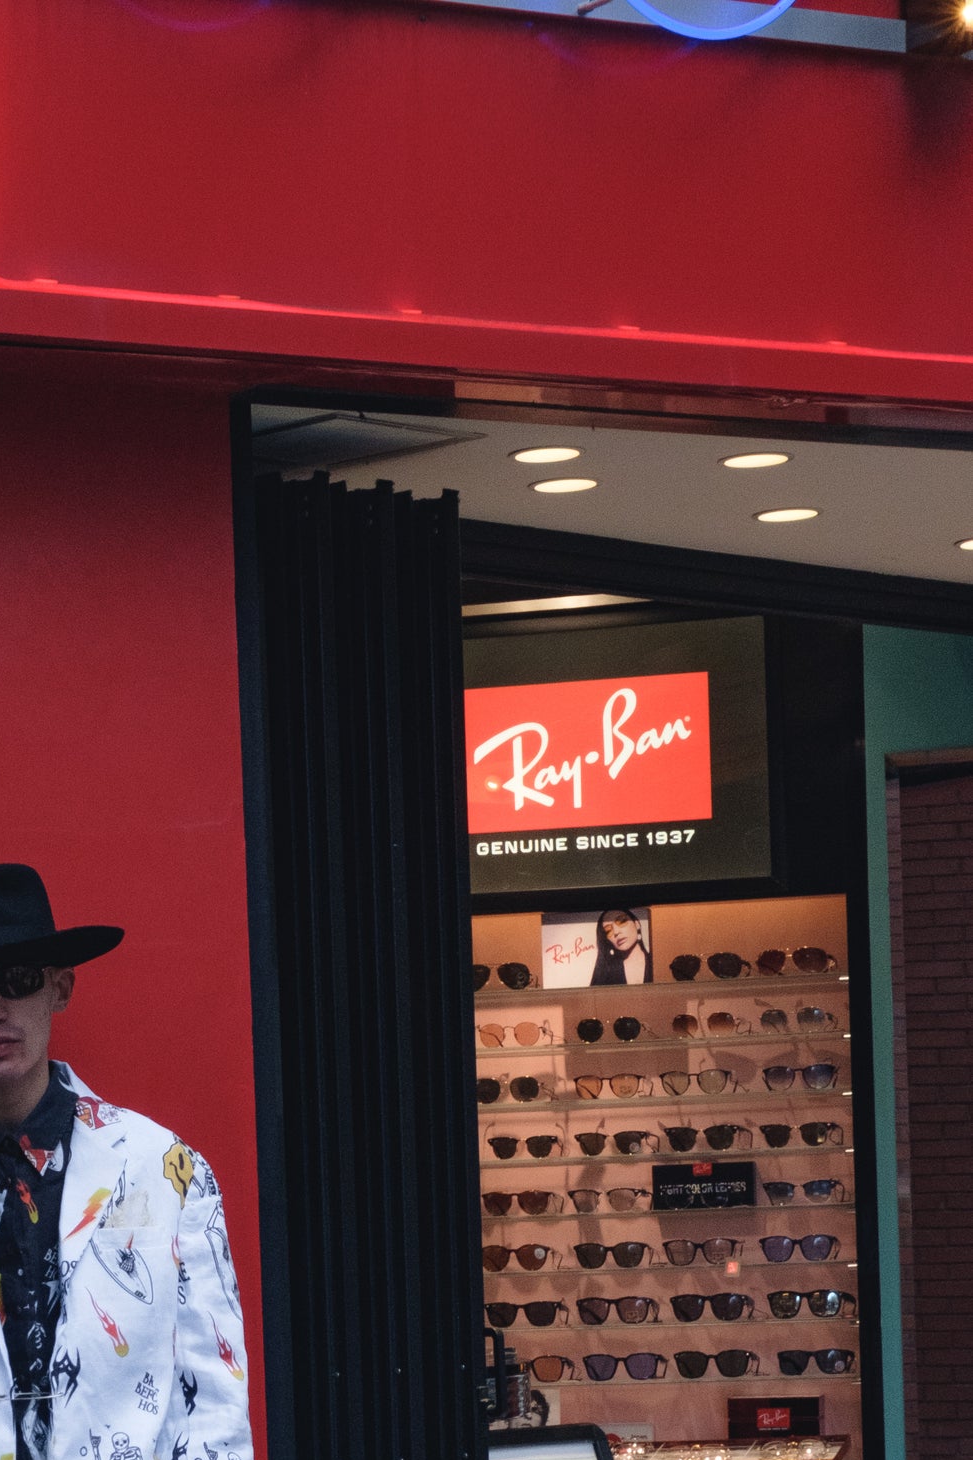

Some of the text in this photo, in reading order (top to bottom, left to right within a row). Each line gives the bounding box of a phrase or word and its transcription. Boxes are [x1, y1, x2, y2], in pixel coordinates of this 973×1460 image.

[476, 829, 696, 856] GENUINE SINCE 1937
